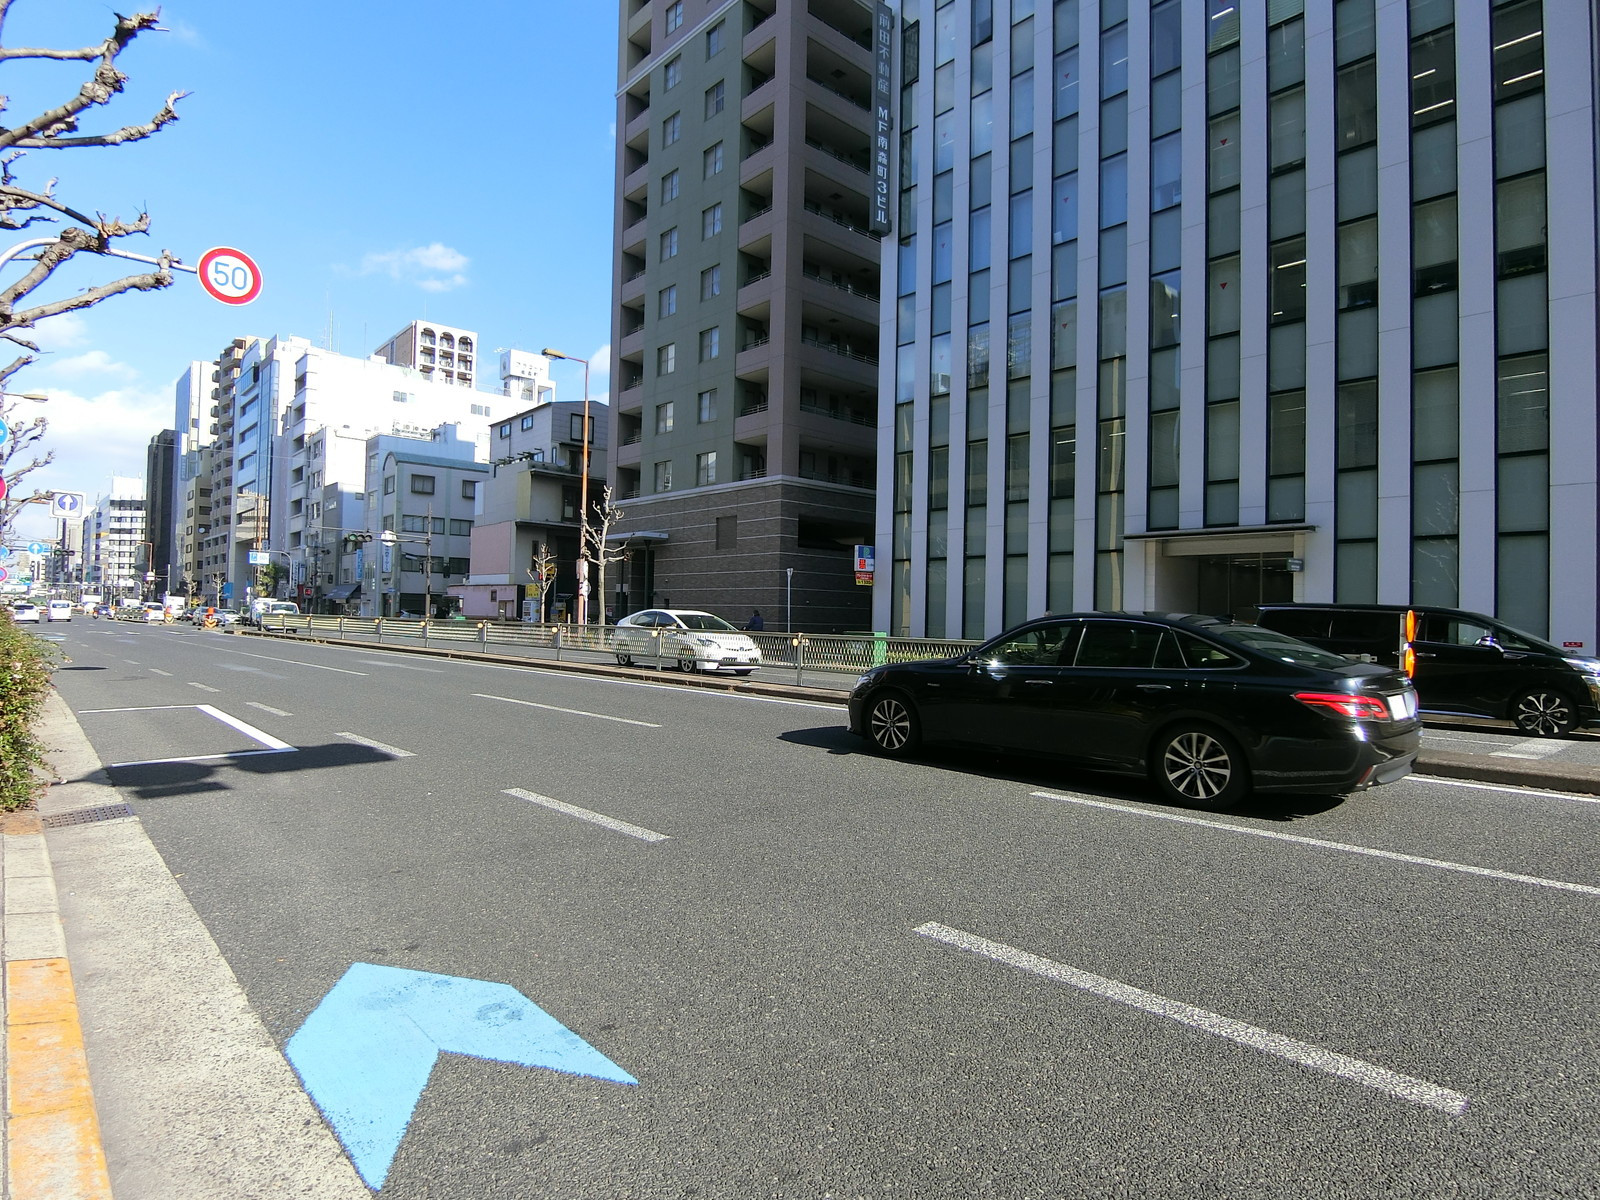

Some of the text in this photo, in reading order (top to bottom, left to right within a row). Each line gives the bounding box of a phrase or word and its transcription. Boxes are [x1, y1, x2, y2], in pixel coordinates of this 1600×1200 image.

[878, 14, 890, 95] 前田不動産
[213, 261, 248, 290] 50
